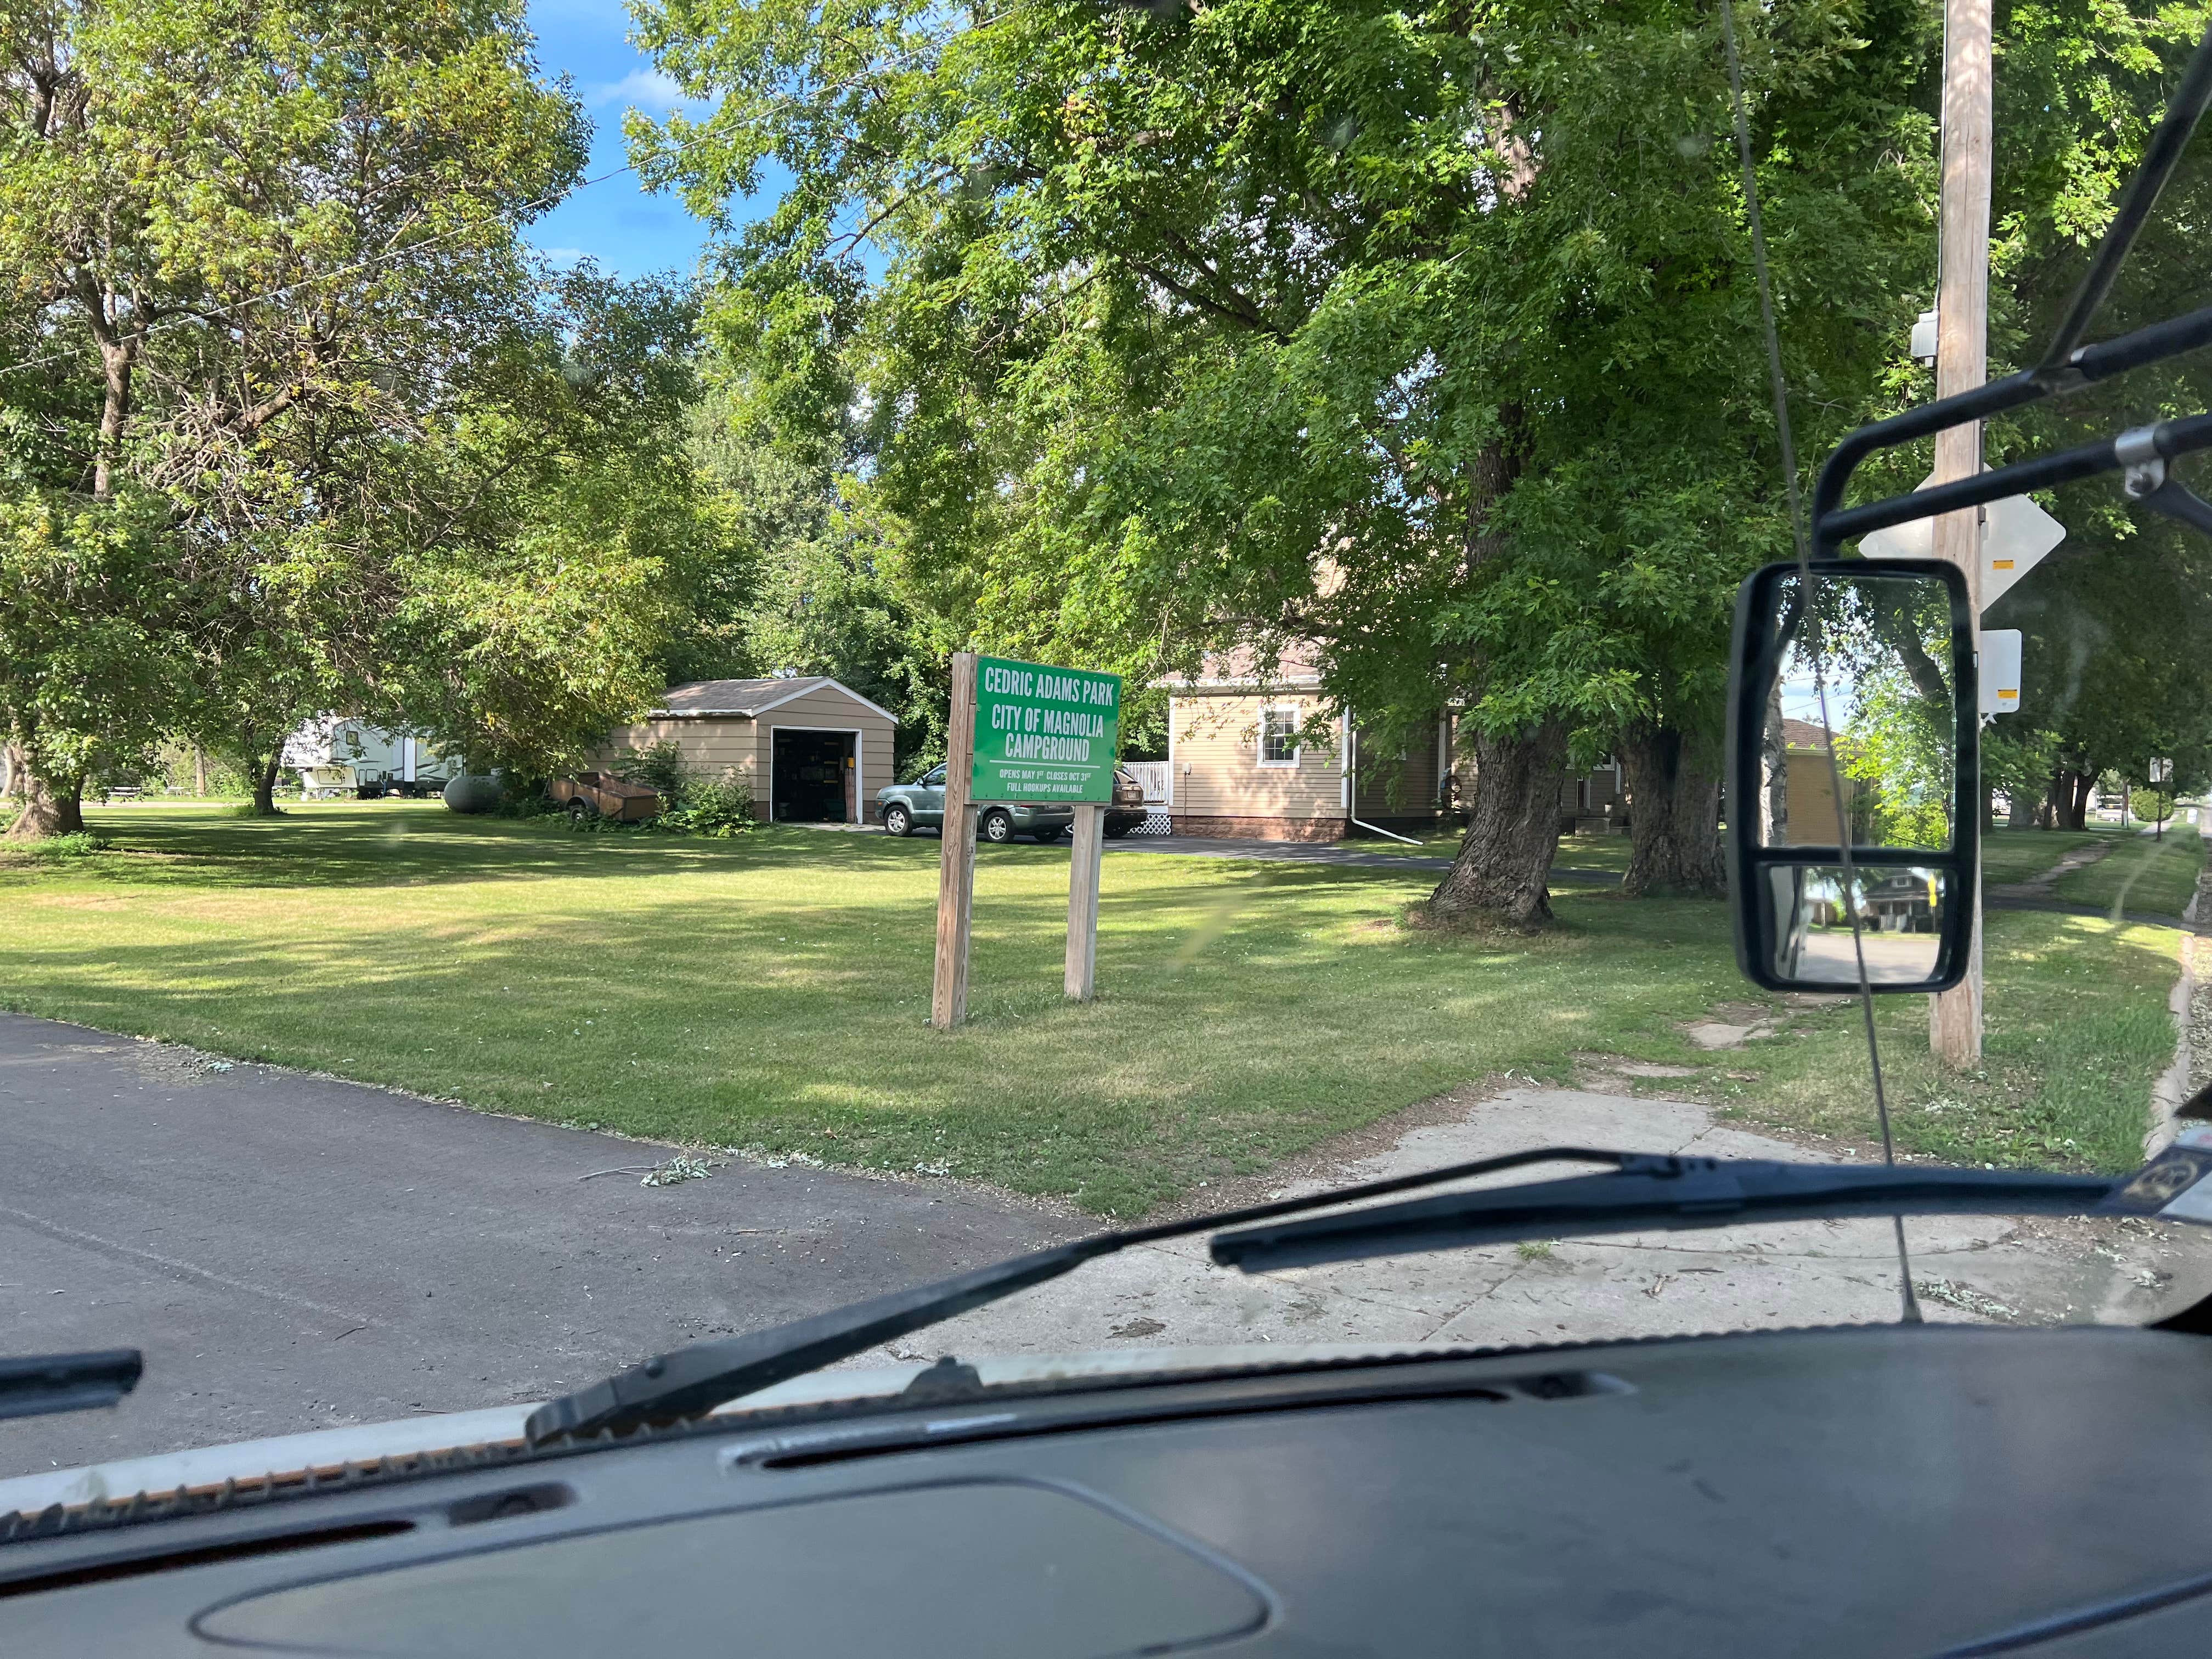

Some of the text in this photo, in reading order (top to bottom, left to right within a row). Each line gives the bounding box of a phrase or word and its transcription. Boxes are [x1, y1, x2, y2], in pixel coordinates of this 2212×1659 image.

[985, 667, 1114, 706] CEDRIC ADAMS PARK
[992, 704, 1103, 737] CITY OF MAGNOLIA
[1005, 733, 1090, 761] CAMPGROUND
[1000, 769, 1020, 778] OPENS
[1022, 770, 1035, 779] MAY
[1047, 771, 1068, 781] CLOSES
[1069, 772, 1080, 781] OCT
[1007, 782, 1083, 793] FULL HOOKUPS AVAILABLE
